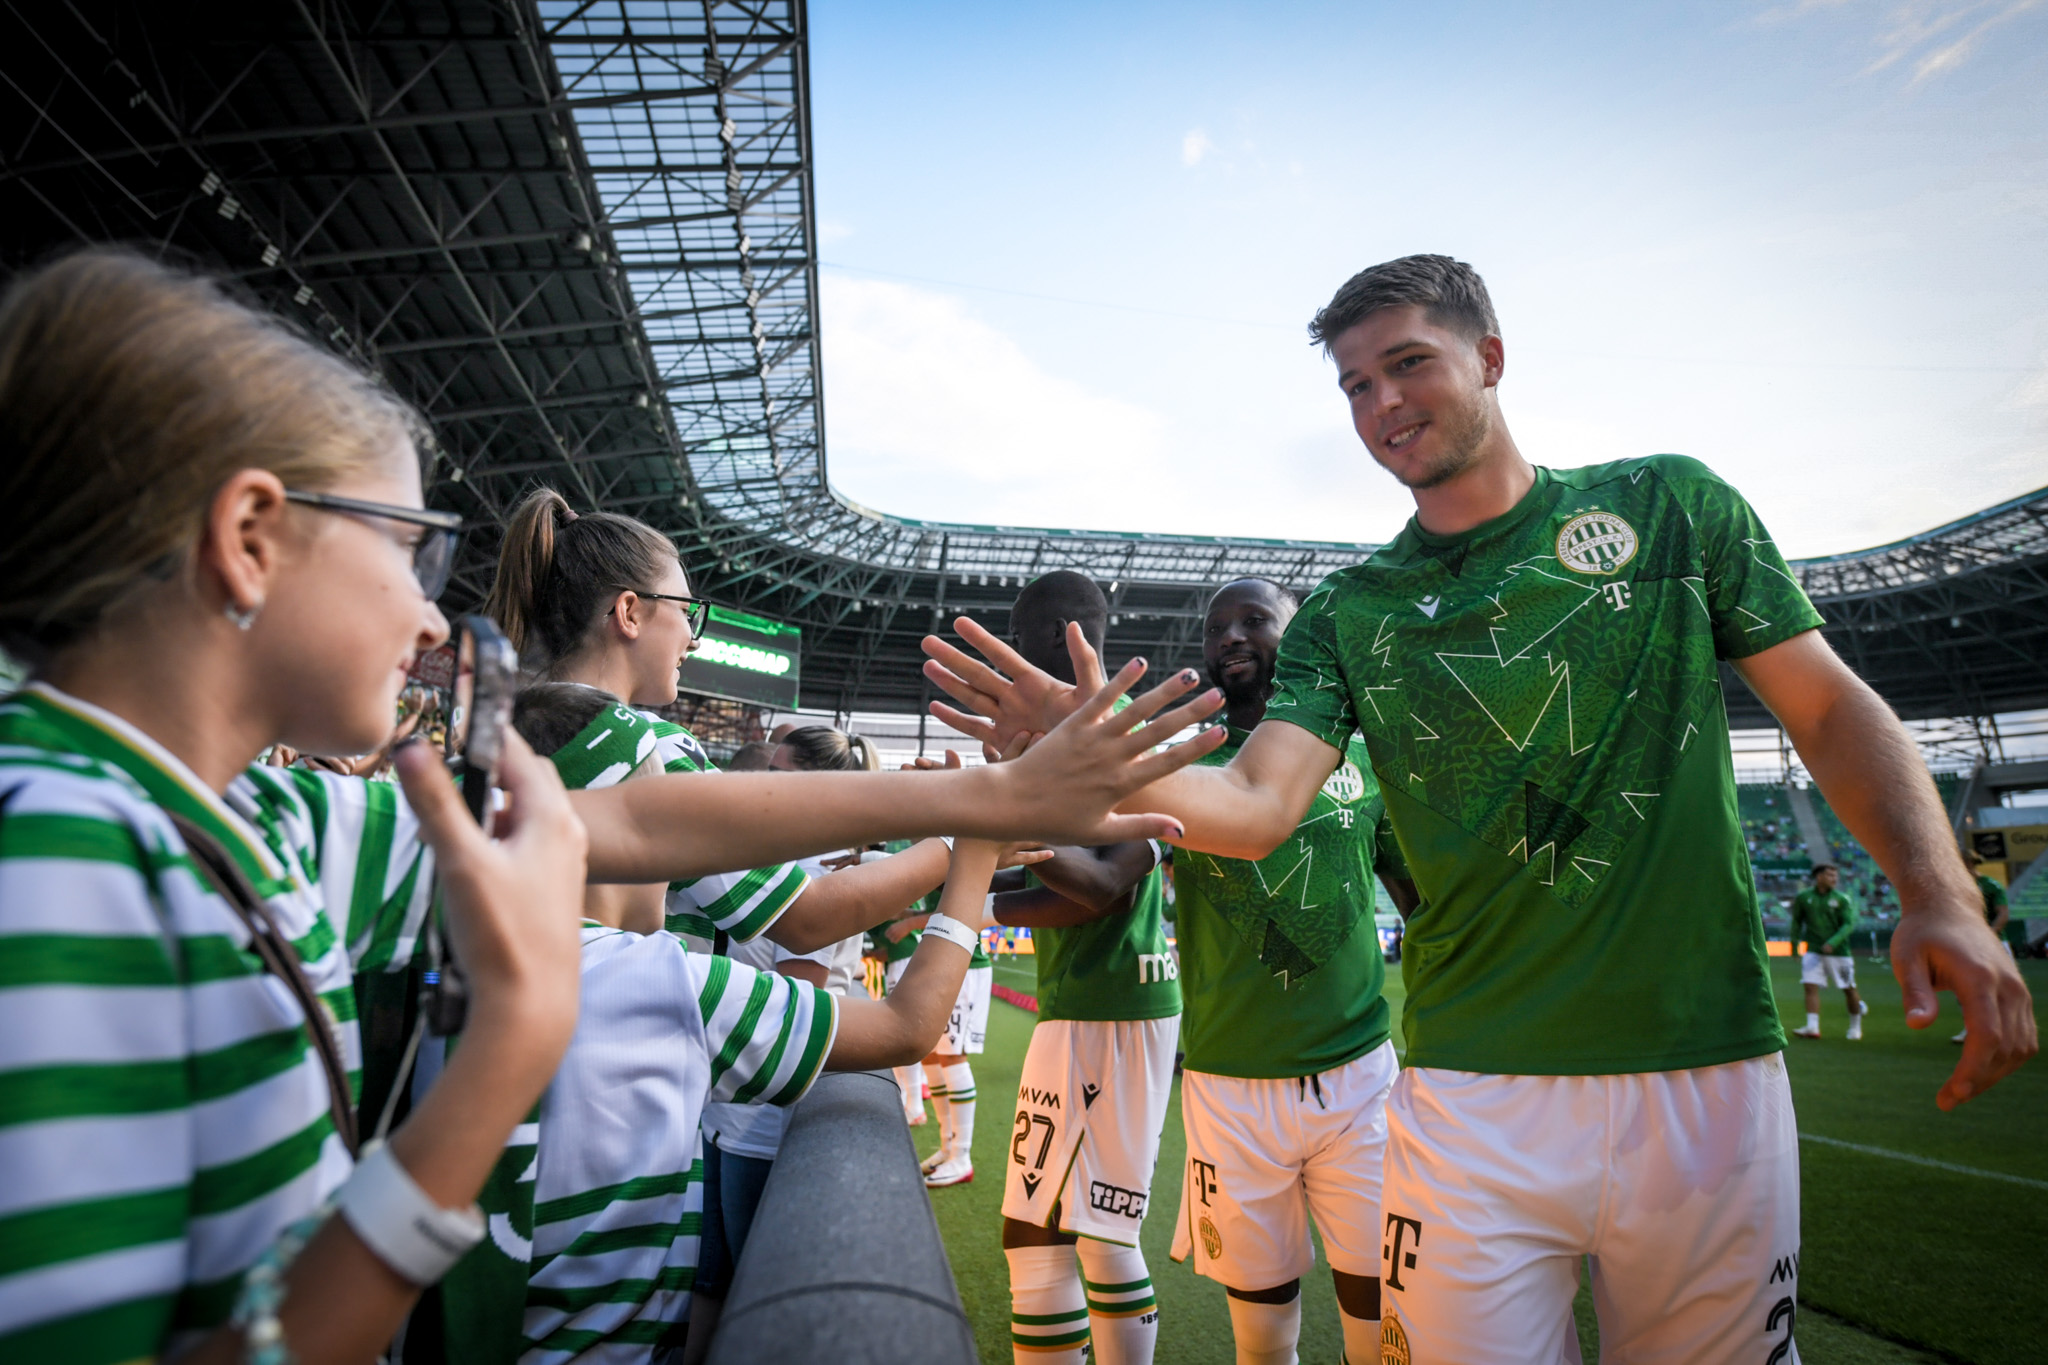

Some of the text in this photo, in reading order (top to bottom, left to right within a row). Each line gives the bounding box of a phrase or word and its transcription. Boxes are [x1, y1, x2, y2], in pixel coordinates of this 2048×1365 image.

[1560, 515, 1634, 563] FERENCVÁROSI TORNA CLUB
[1602, 580, 1632, 612] T
[1338, 808, 1354, 829] T
[1018, 1085, 1061, 1110] MVM
[1012, 1110, 1056, 1171] 27
[1192, 1157, 1217, 1208] T
[1383, 1212, 1423, 1293] T
